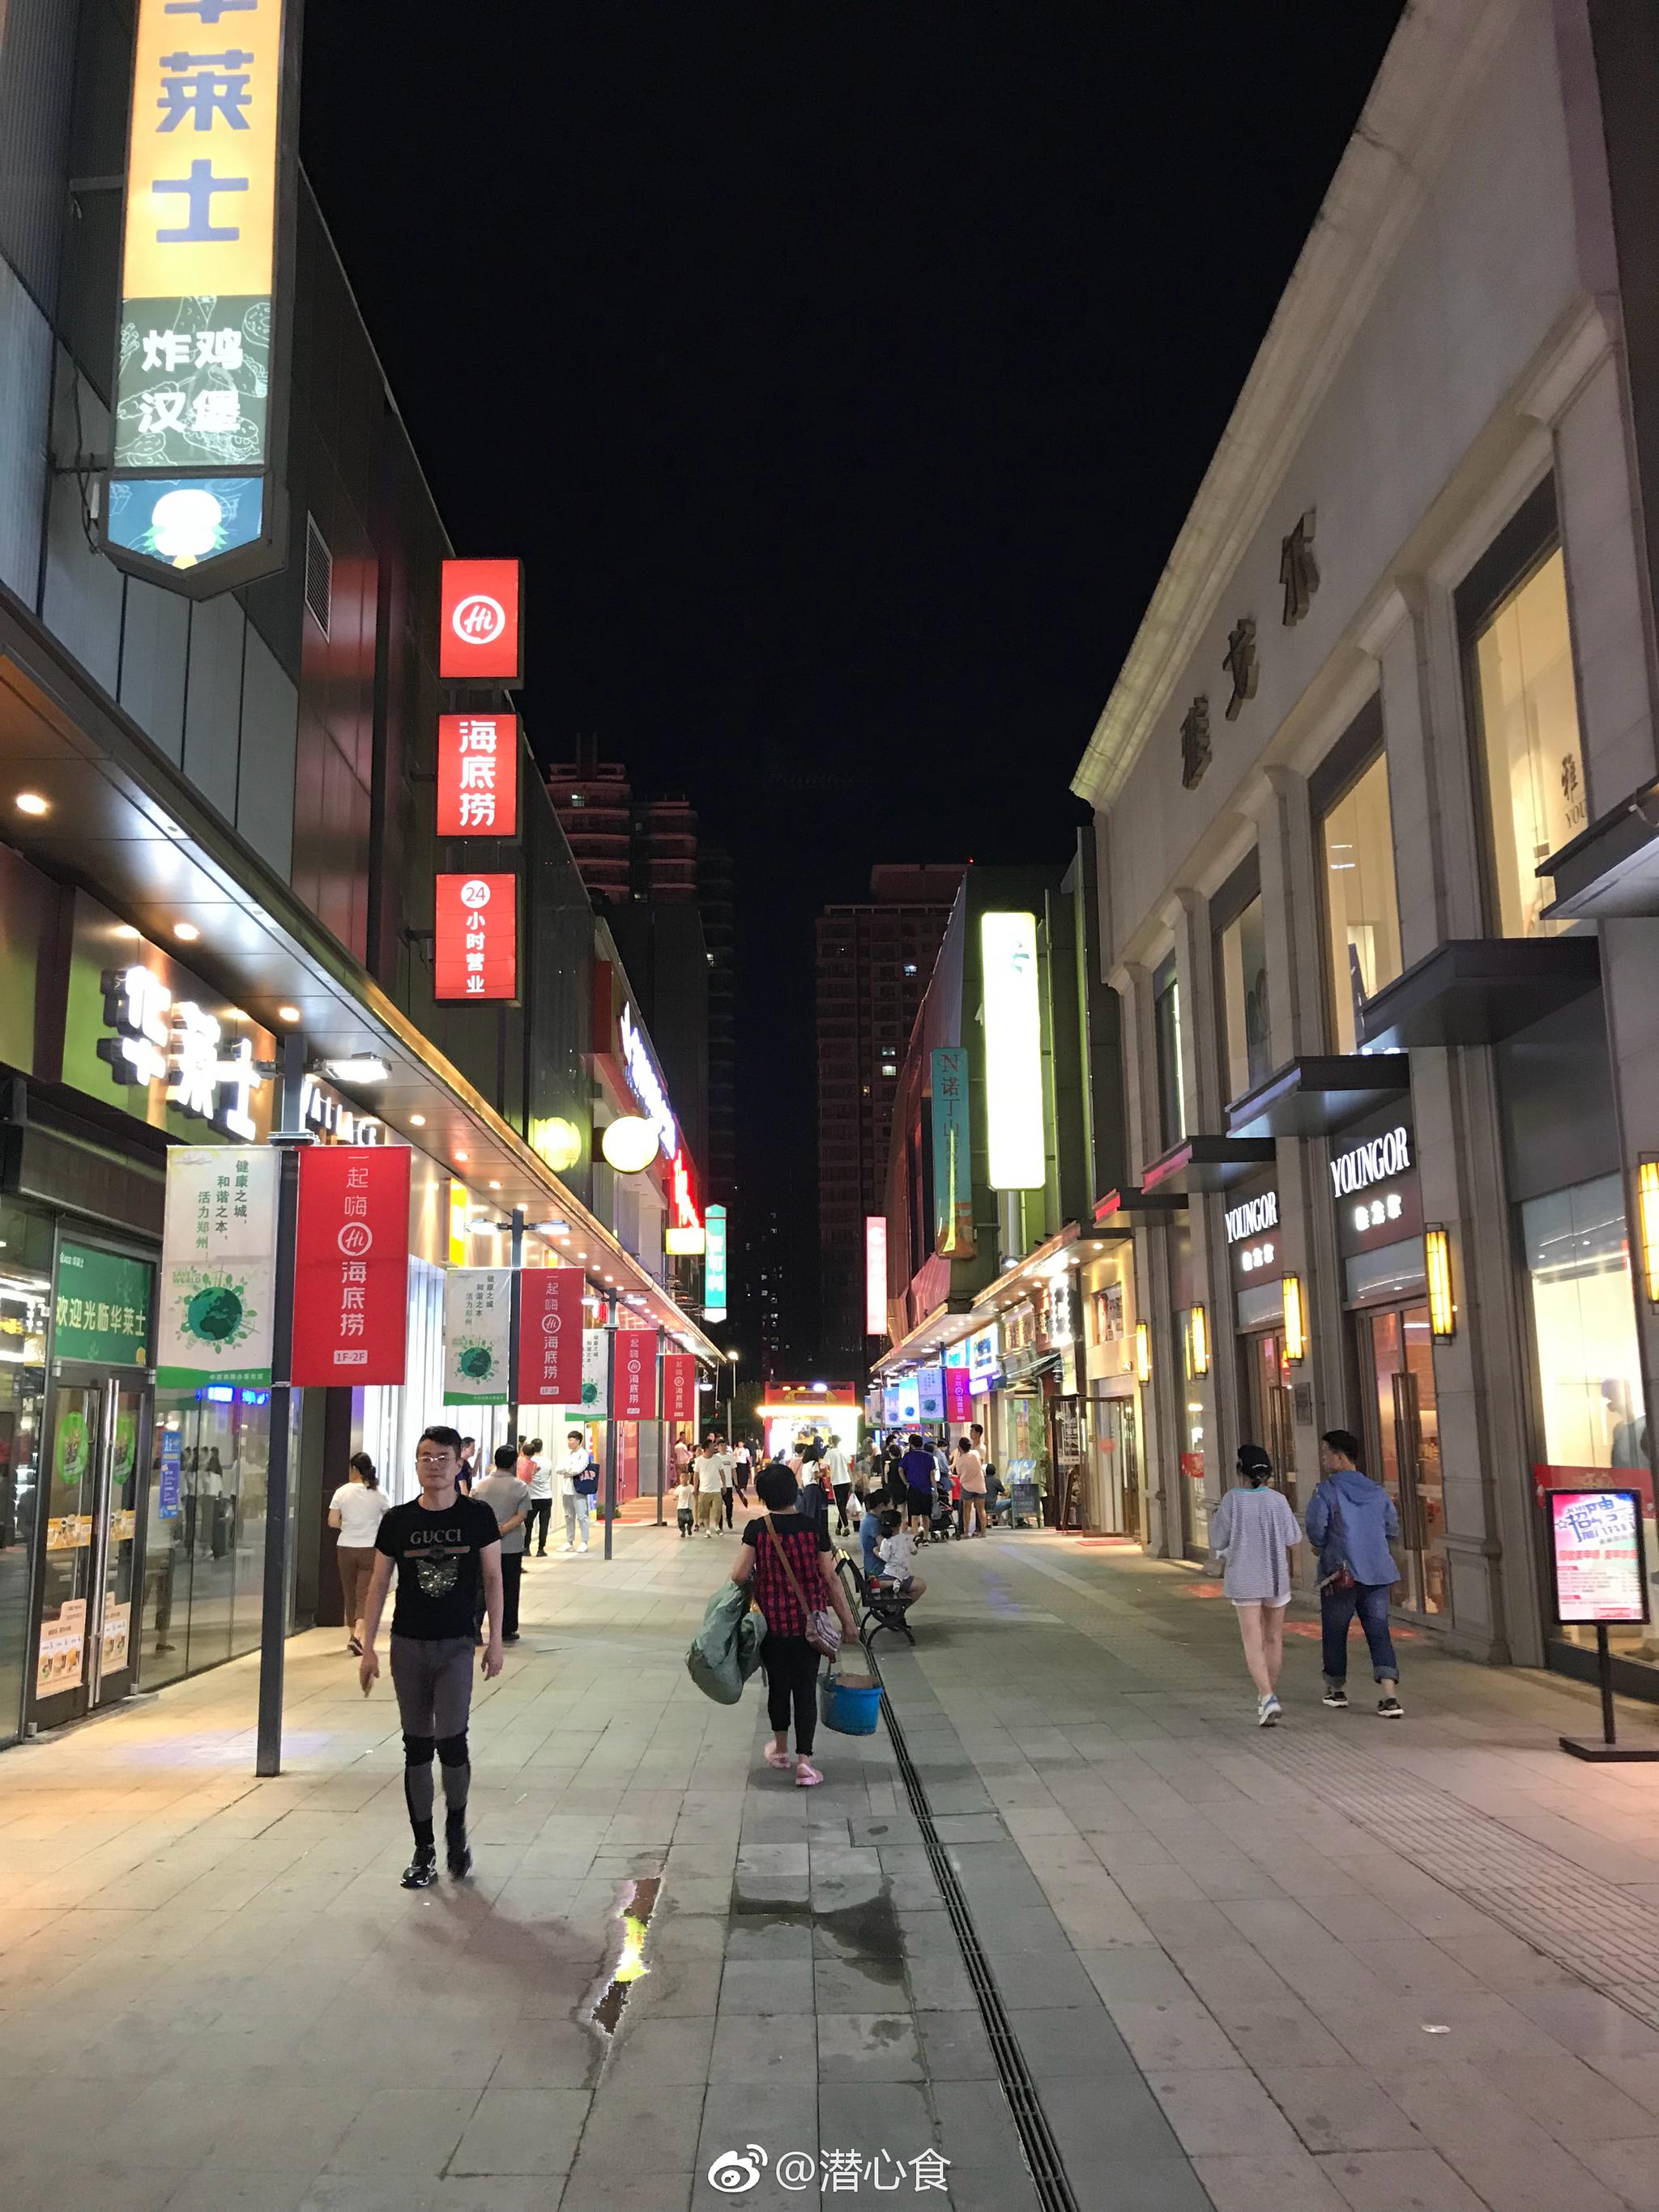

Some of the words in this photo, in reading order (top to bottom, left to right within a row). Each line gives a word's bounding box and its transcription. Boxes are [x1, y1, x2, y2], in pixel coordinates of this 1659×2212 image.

[151, 0, 258, 243] 莱士
[141, 327, 243, 372] 炸鸡
[138, 390, 241, 433] 汉堡
[463, 604, 493, 634] Hi
[458, 719, 497, 827] 海底捞
[940, 1076, 961, 1137] 诺丁山
[343, 1155, 369, 1217] 一起嗨
[1330, 1127, 1410, 1198] YOUNGOR
[1225, 1191, 1278, 1243] YOUNGOR
[56, 1295, 147, 1336] 欢迎光临华莱士
[340, 1260, 367, 1336] 海底捞
[335, 1352, 366, 1362] 1F-2F
[544, 1336, 558, 1379] 海底捞
[410, 1528, 462, 1545] GUCCI
